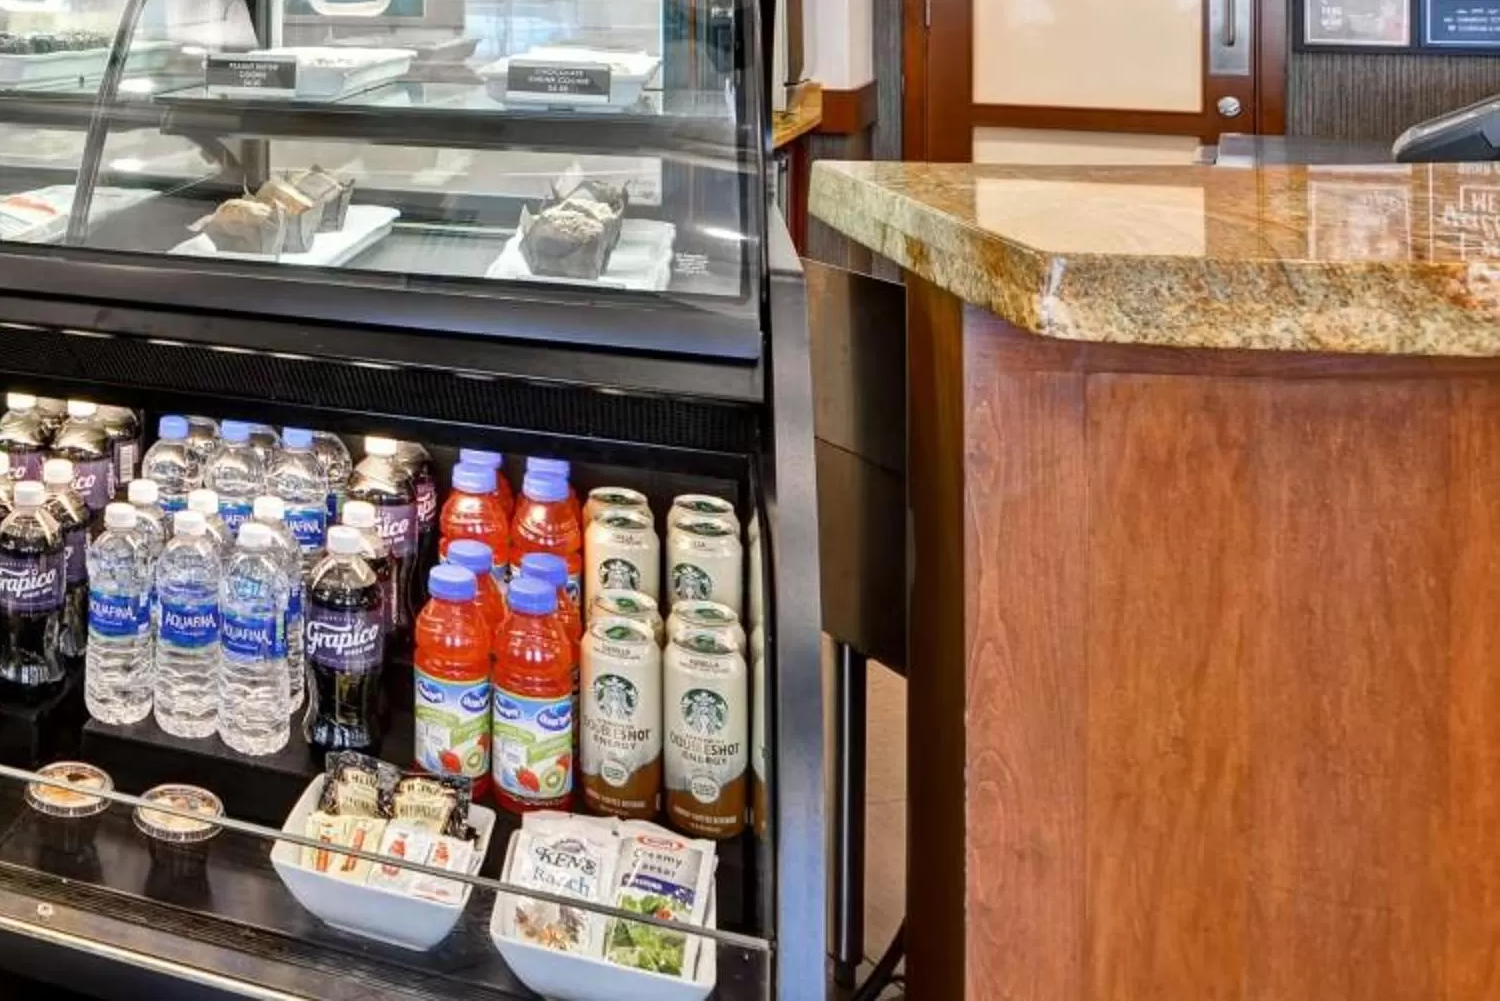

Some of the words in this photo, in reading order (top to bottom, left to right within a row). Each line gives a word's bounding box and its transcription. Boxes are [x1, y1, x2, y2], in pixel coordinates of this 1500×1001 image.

[165, 612, 217, 629] AQUAFINA
[308, 619, 379, 656] Grapico
[532, 866, 590, 897] Rach
